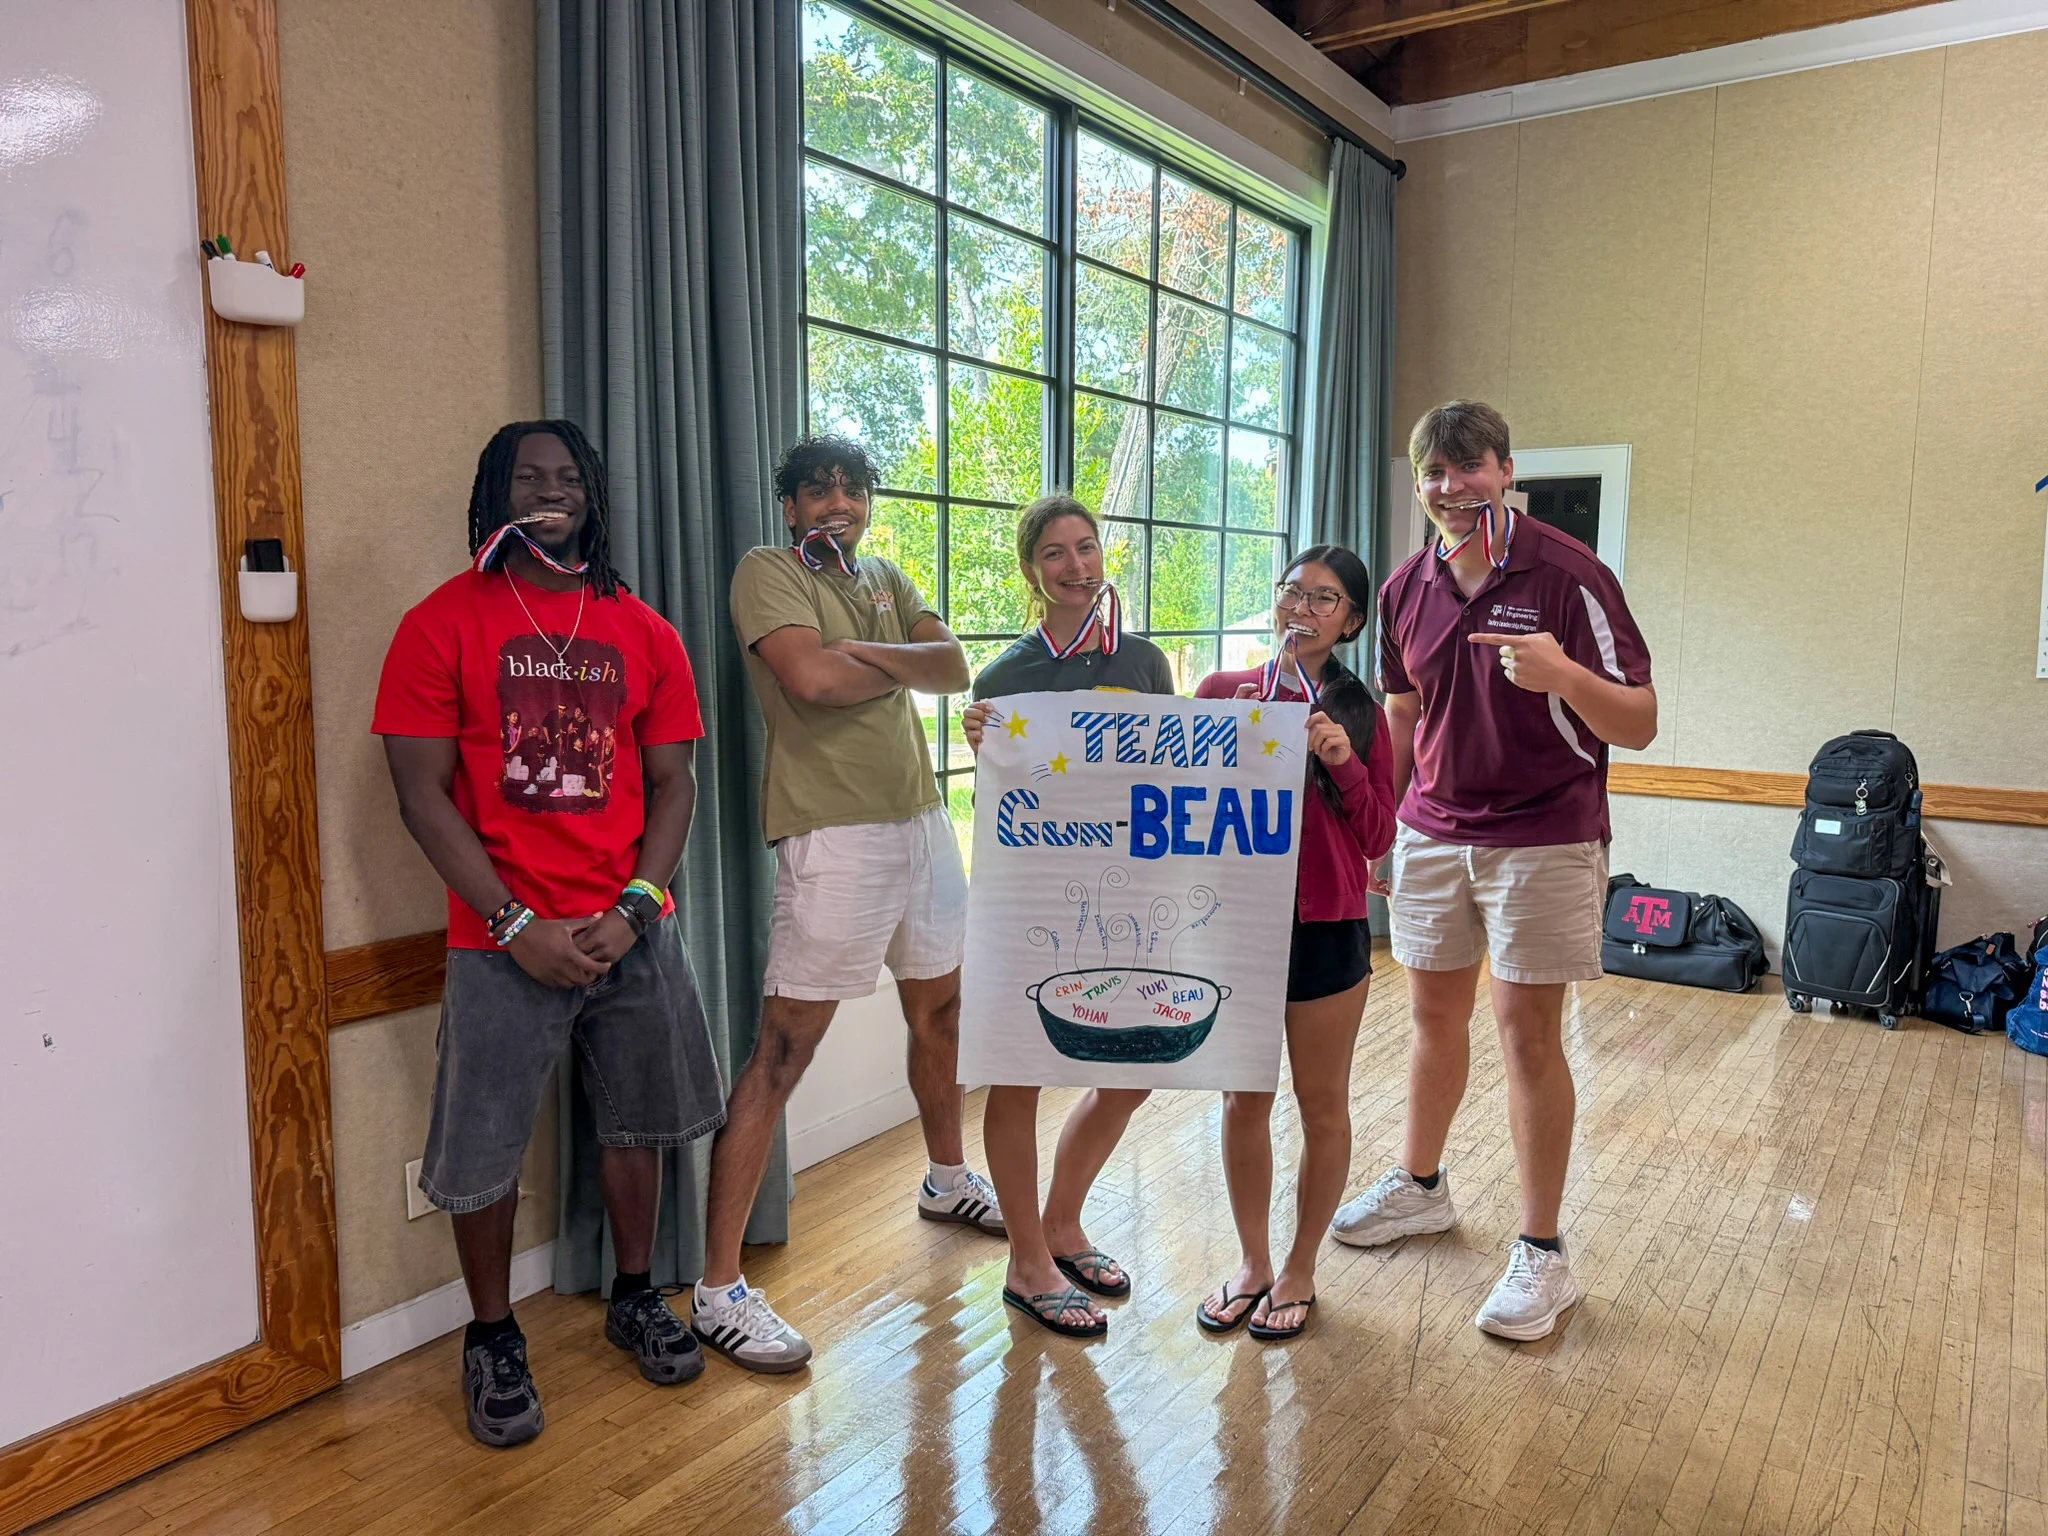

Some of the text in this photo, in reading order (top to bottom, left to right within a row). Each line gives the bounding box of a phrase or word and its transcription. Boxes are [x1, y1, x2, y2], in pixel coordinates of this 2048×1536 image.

[1506, 610, 1538, 621] Engineering
[1071, 711, 1238, 768] TEAM
[1055, 981, 1083, 997] ERIN
[1082, 976, 1122, 1001] TRAVIS
[1137, 978, 1169, 1000] YUKI
[1172, 988, 1204, 1004] BEAU
[1072, 1003, 1109, 1024] YOHAN
[1153, 1002, 1191, 1024] JACOB
